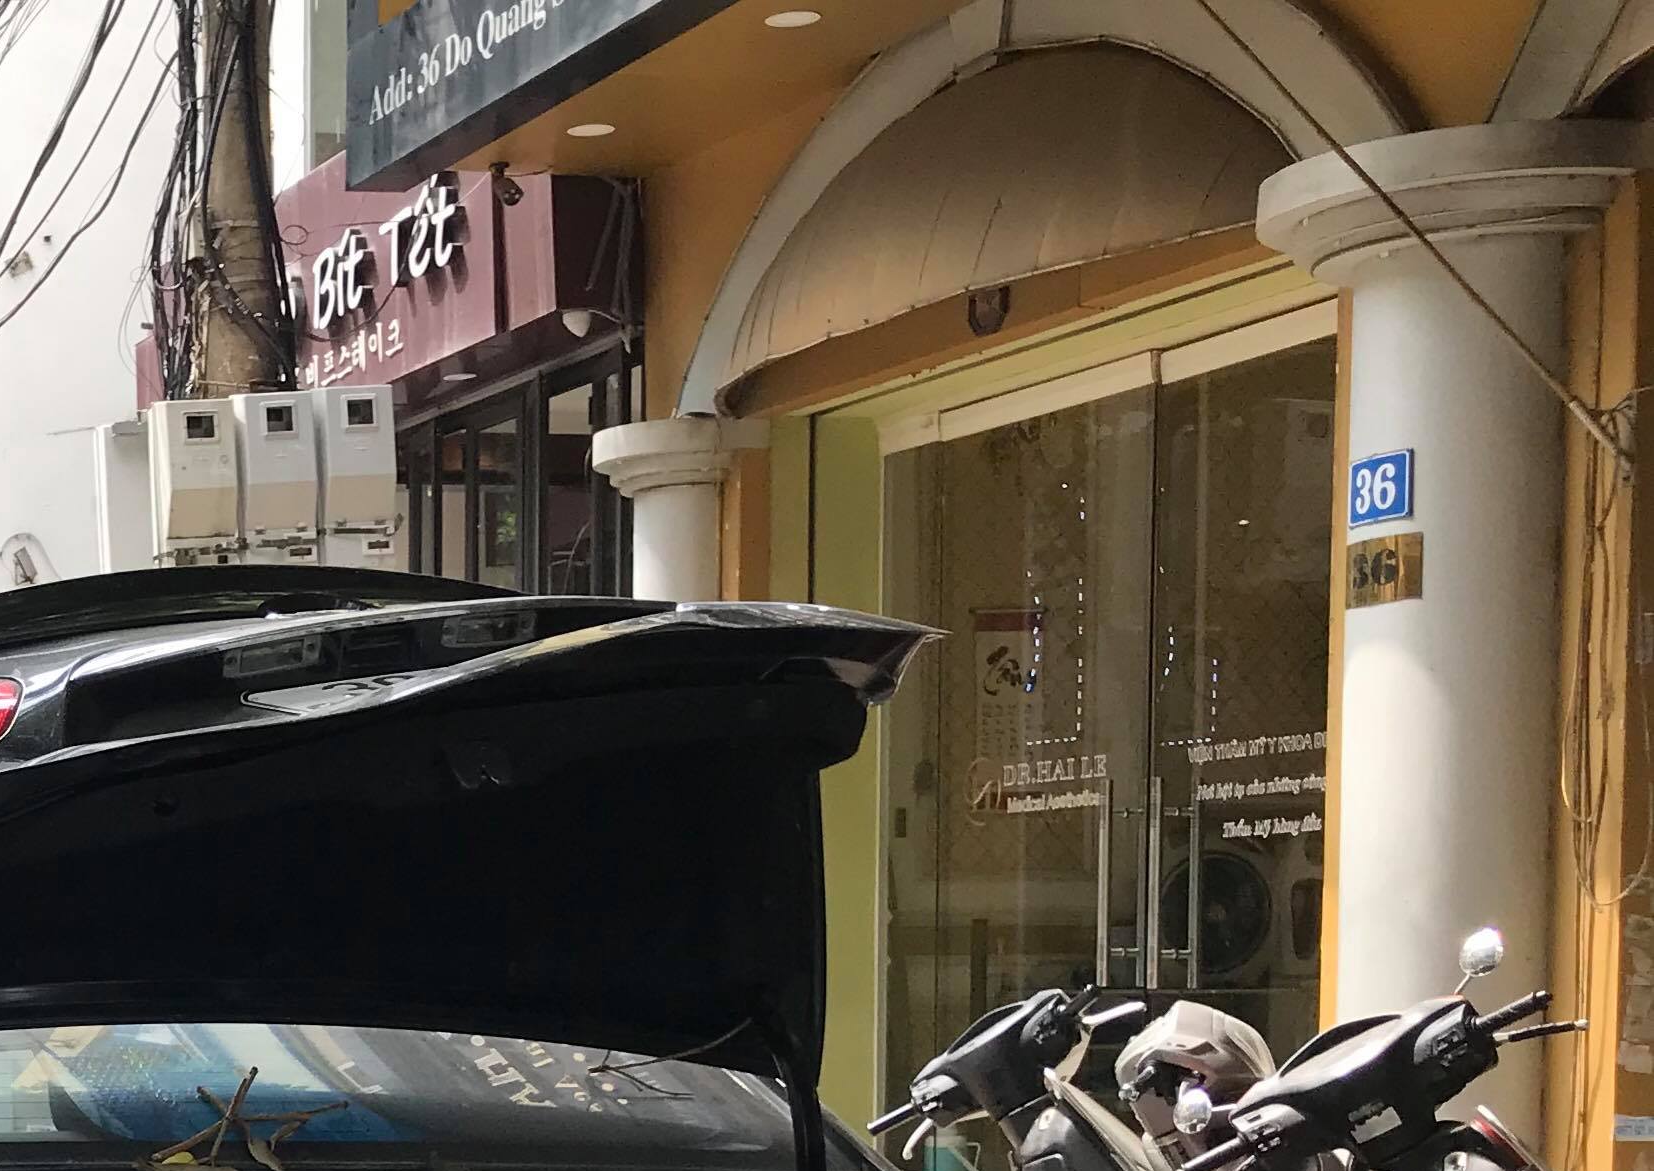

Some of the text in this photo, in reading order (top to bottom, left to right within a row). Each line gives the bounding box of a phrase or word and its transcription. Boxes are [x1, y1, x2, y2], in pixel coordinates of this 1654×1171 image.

[368, 0, 546, 125] Add: 36 Do Quang
[1355, 462, 1396, 515] 36
[1352, 548, 1396, 590] 36
[1080, 754, 1107, 779] LE
